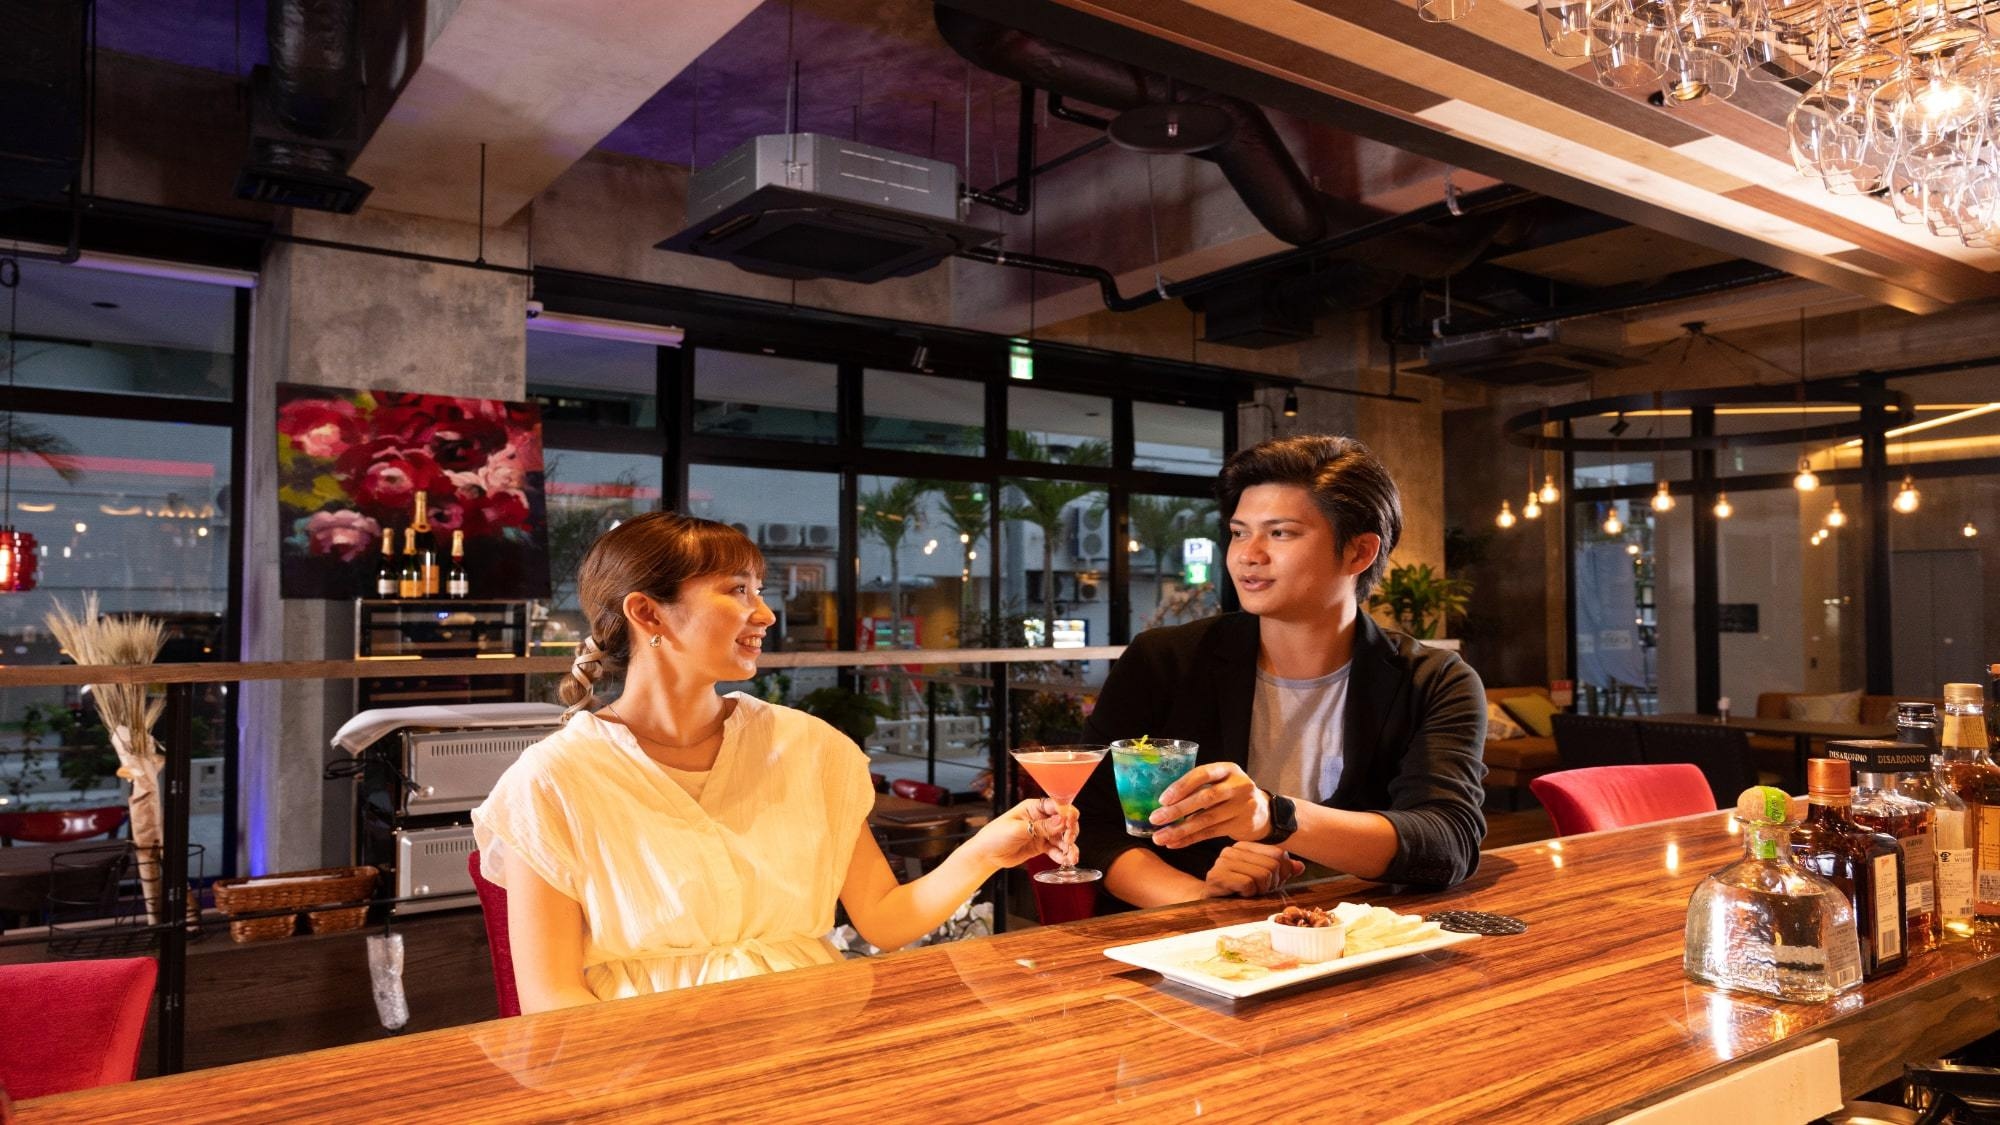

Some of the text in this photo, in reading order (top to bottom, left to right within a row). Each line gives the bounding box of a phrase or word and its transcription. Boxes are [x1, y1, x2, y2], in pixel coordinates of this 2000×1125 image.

[1190, 543, 1202, 554] P
[1828, 750, 1868, 763] DISARONNO
[1878, 754, 1926, 764] DISARONNO
